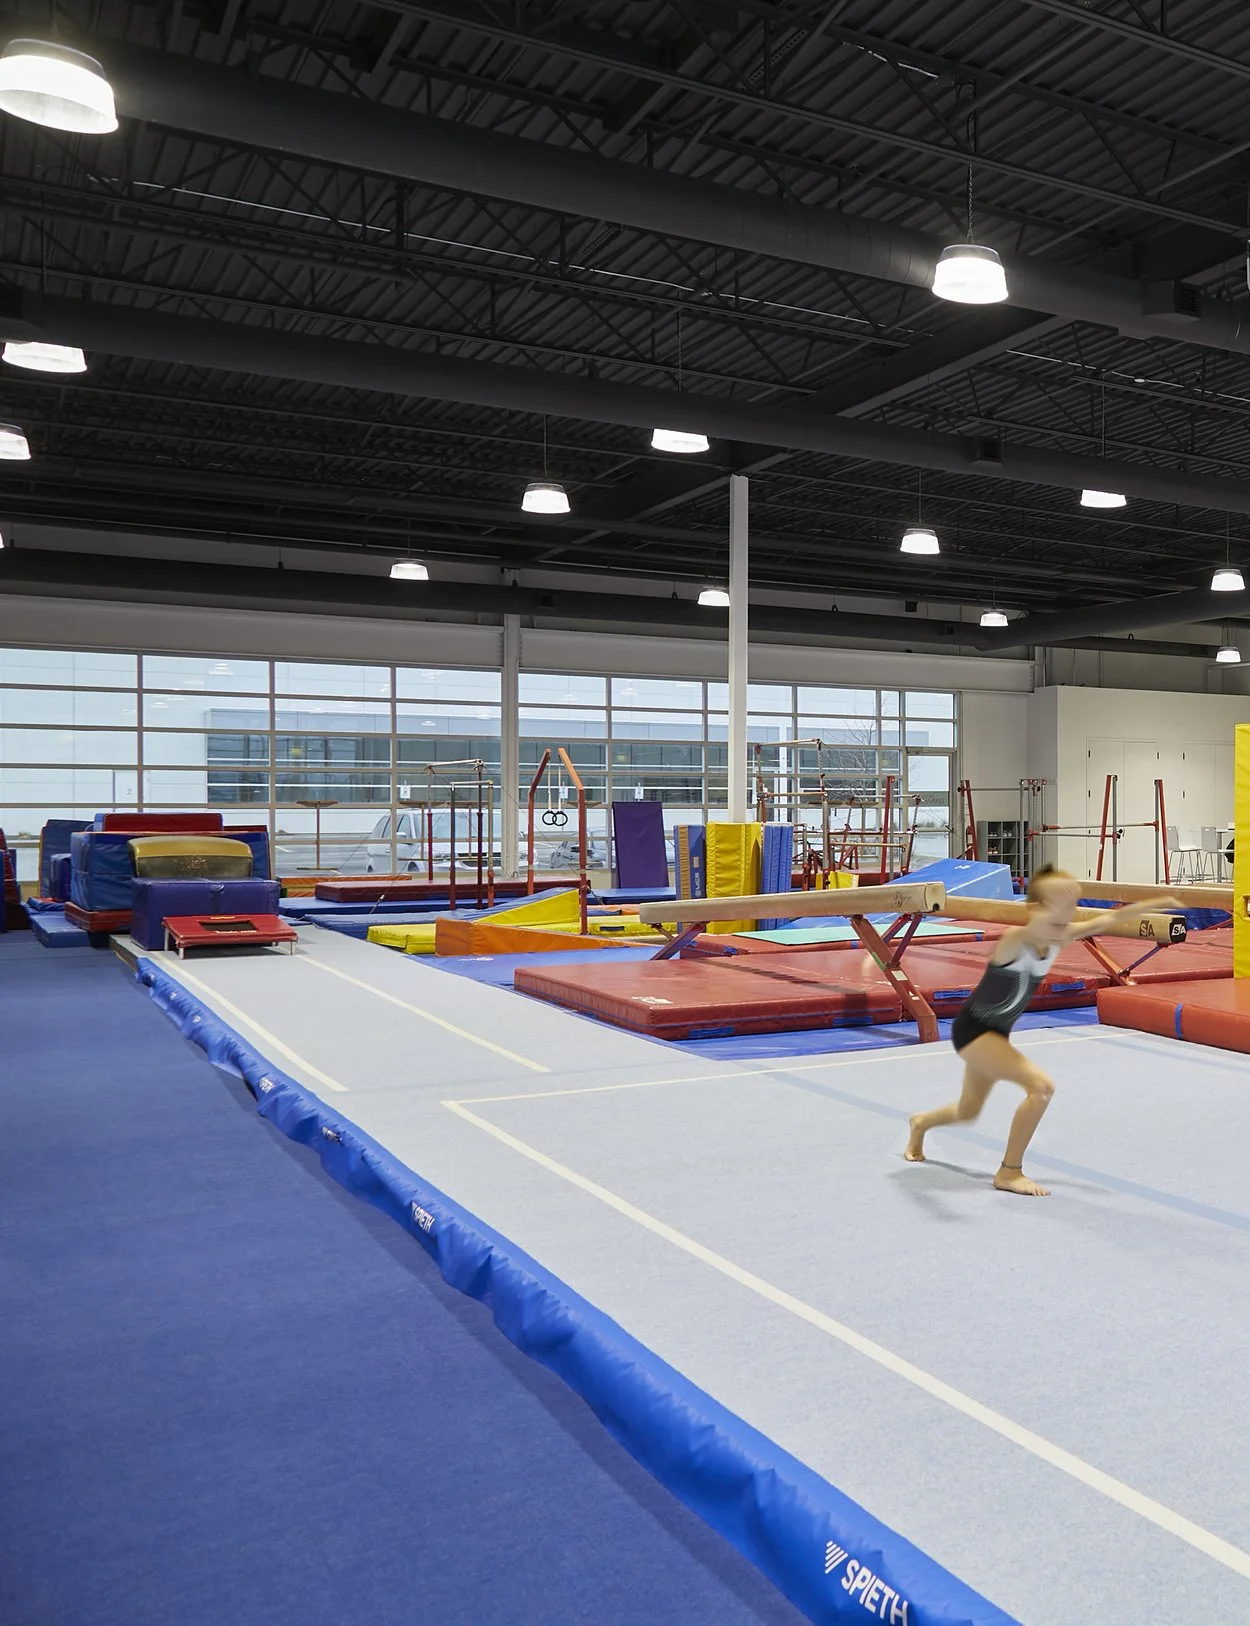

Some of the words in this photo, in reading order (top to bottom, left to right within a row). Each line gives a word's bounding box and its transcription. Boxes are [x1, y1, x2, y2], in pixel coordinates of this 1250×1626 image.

[1139, 920, 1156, 938] SA
[1171, 923, 1187, 936] SA
[414, 1206, 435, 1233] SPIETH
[840, 1559, 909, 1626] SPIETH
